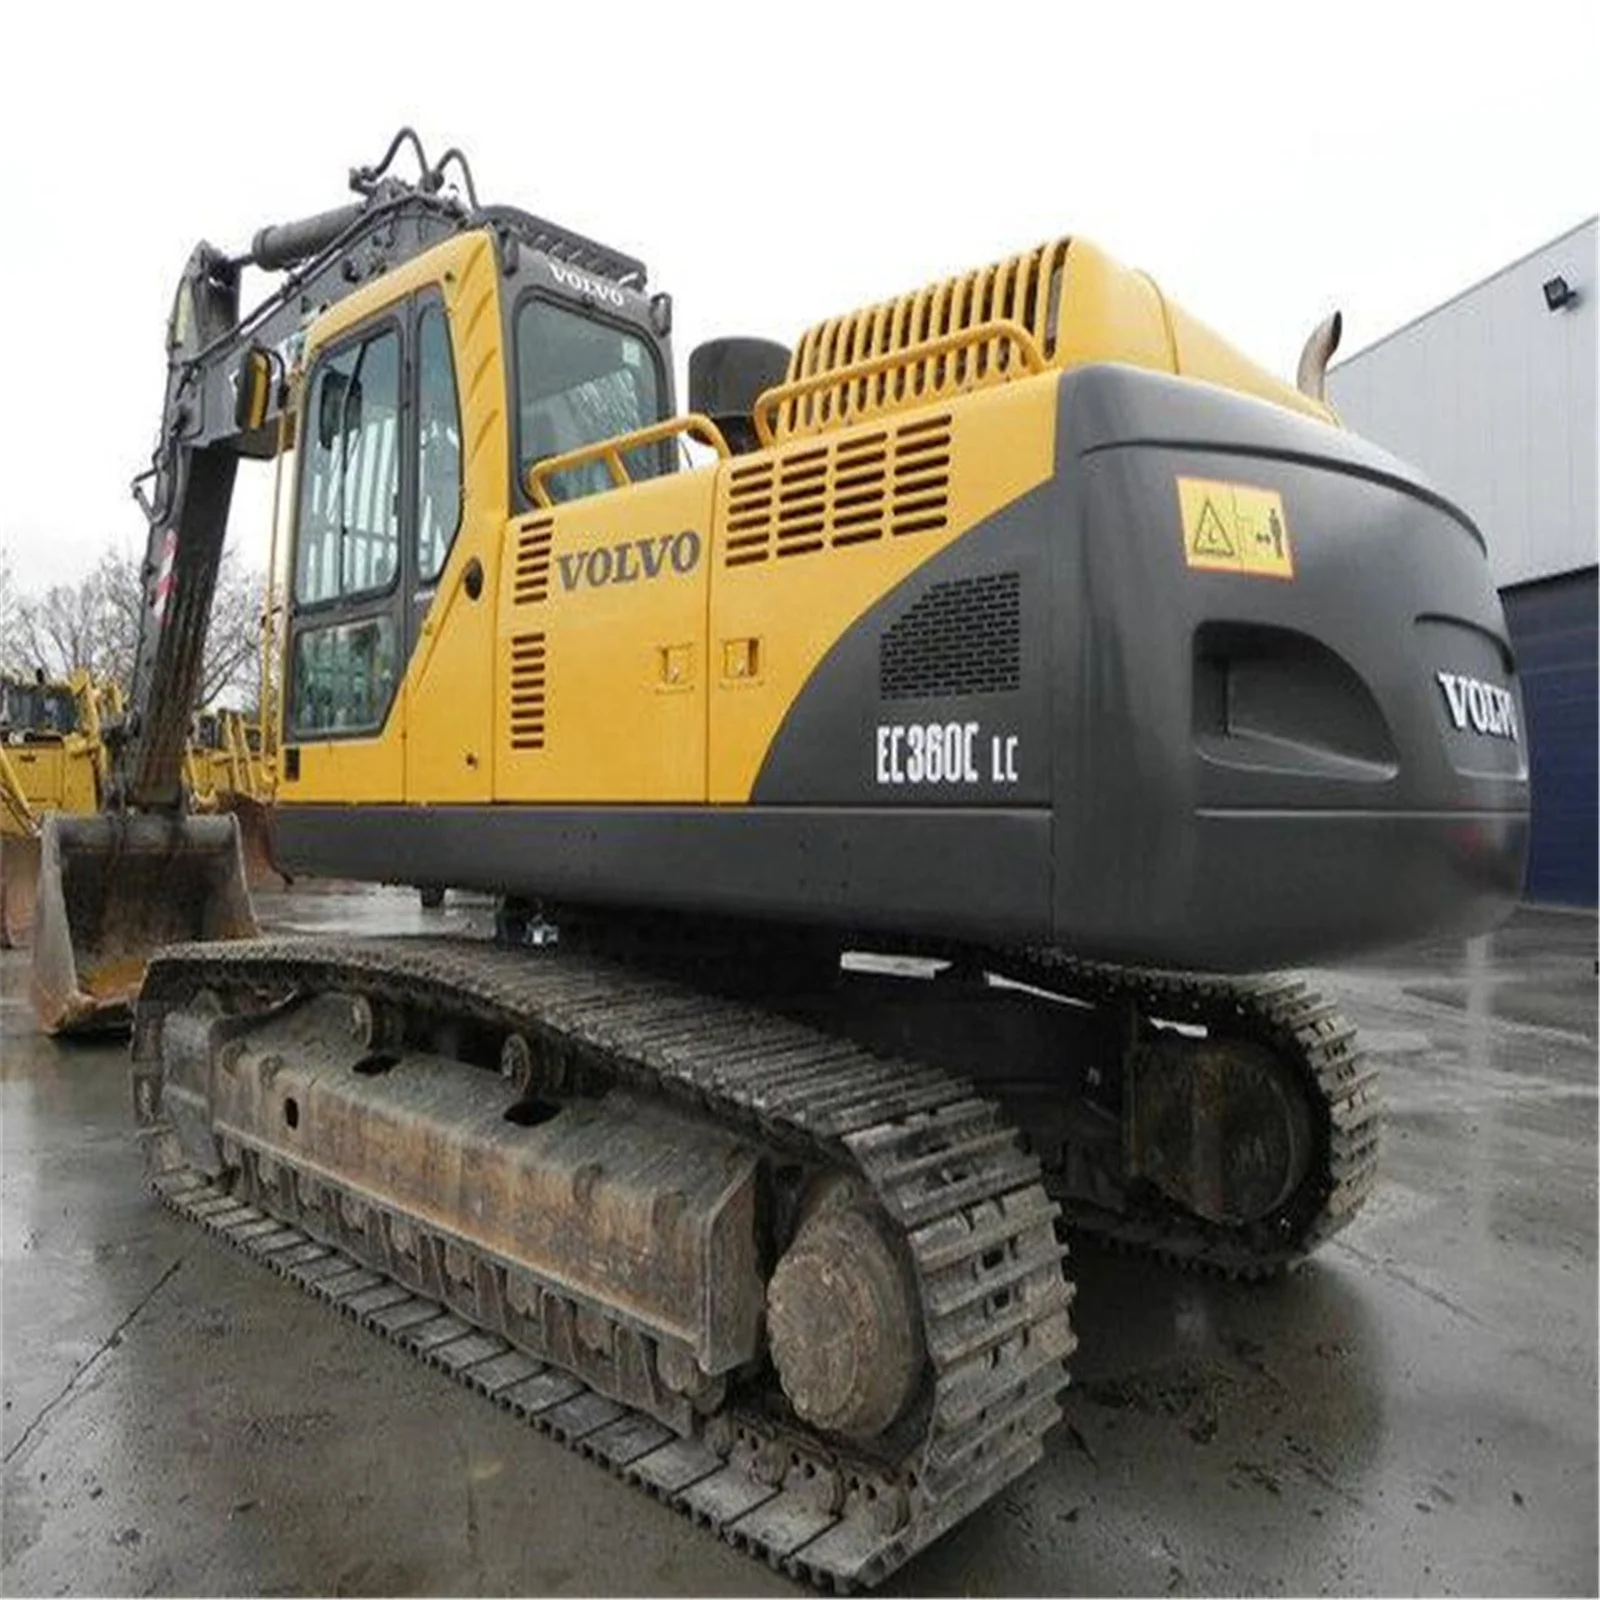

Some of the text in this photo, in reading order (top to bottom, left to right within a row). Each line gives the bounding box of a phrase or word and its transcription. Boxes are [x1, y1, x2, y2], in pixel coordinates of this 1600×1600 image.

[548, 262, 624, 307] VOLVO
[556, 530, 701, 591] VOLVO
[1437, 671, 1518, 741] VOLV
[877, 722, 1018, 783] EC360C LC
